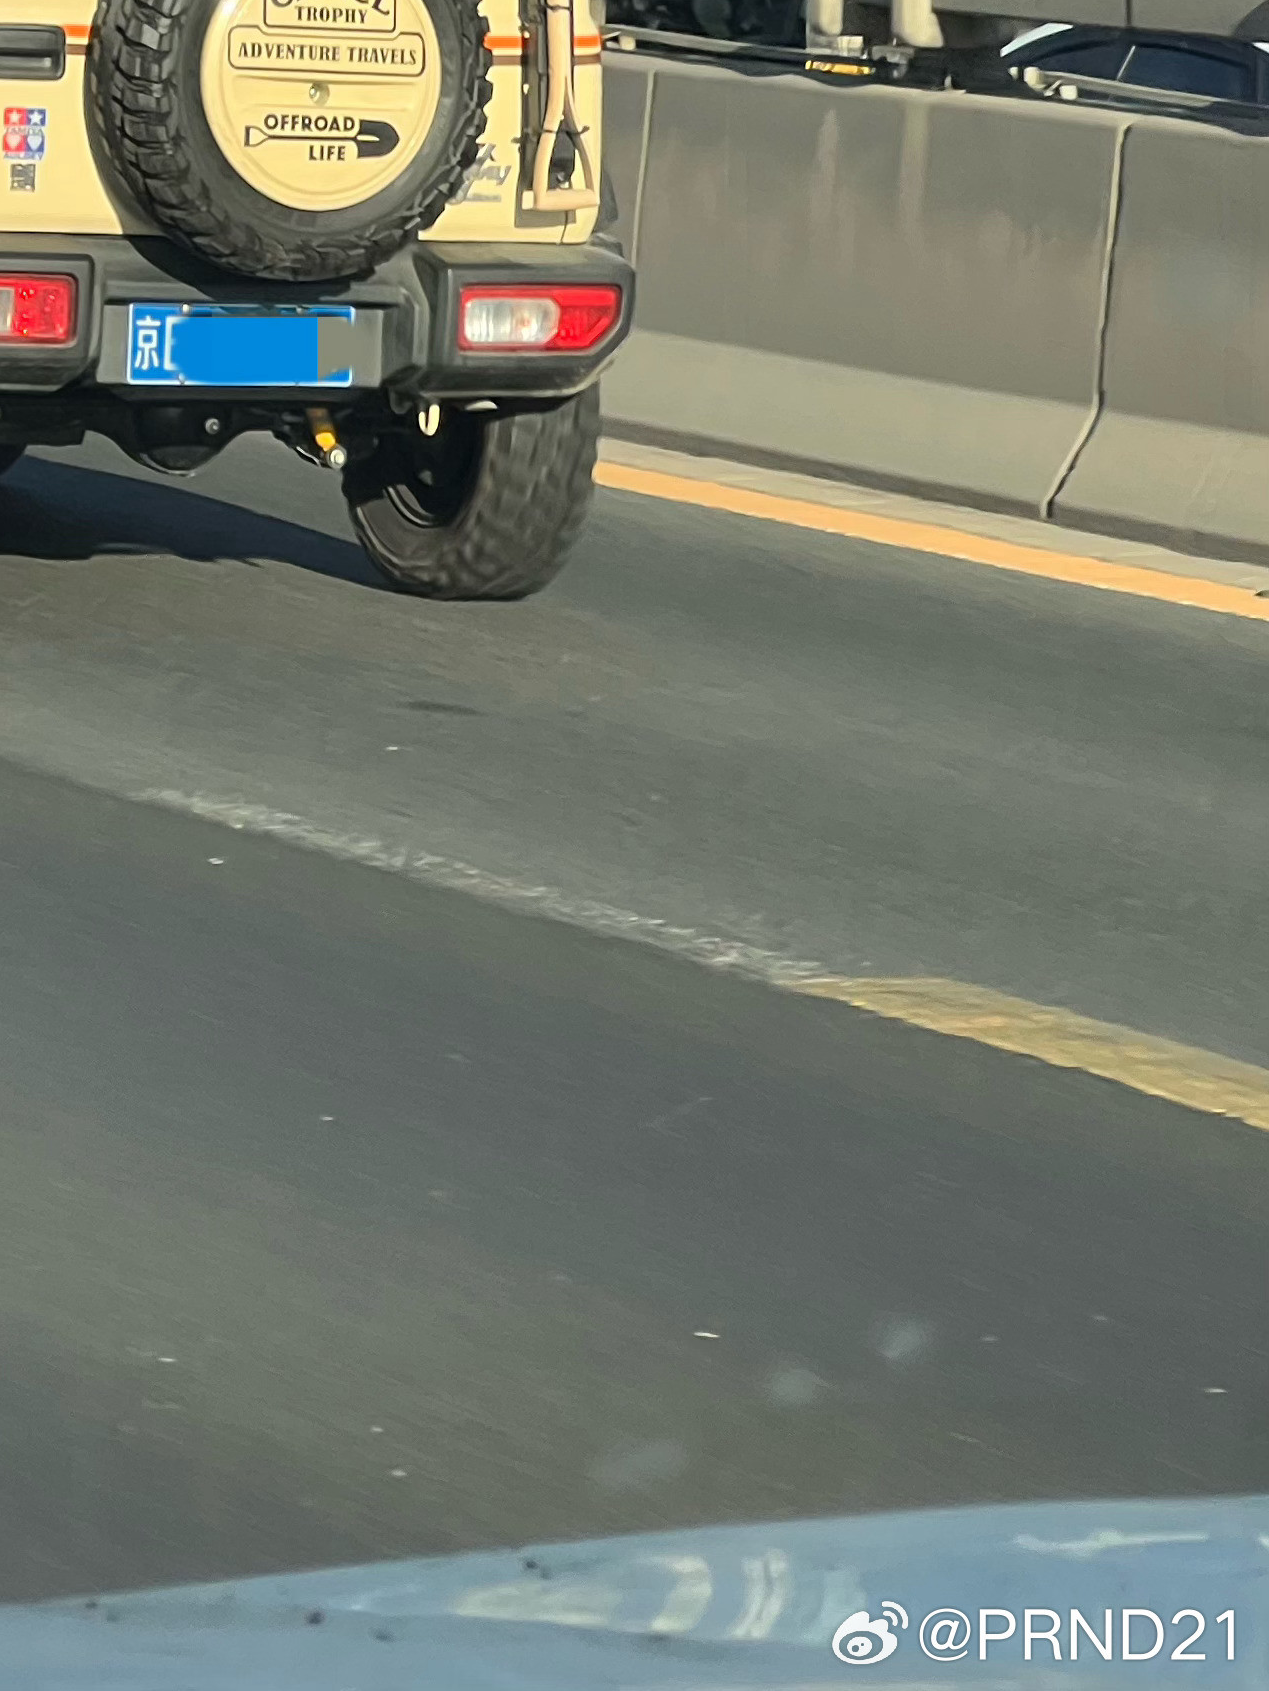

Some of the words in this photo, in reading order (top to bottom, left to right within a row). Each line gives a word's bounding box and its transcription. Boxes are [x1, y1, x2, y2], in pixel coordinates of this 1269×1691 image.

[294, 5, 368, 24] TROPHY
[238, 41, 341, 63] ADVENTURE
[347, 46, 417, 65] TRAVELS
[264, 114, 355, 132] OFFROAD
[308, 145, 346, 161] LIFE
